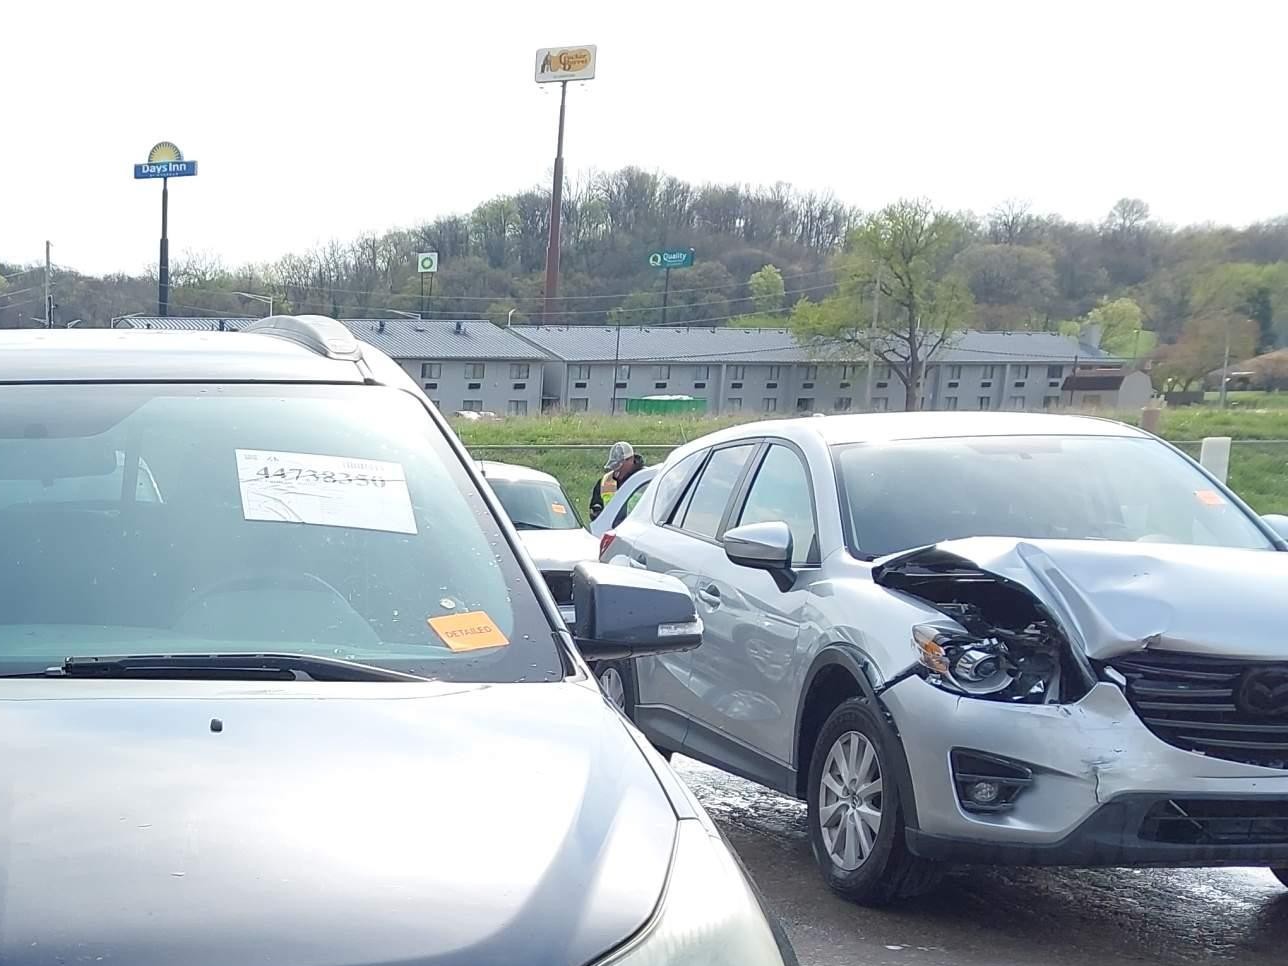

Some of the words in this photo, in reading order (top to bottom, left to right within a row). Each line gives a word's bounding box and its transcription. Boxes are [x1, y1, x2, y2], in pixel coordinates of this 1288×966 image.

[141, 164, 168, 174] Days
[169, 162, 187, 172] Inn
[663, 252, 687, 262] Quality
[256, 466, 387, 489] 44738350
[445, 625, 493, 639] DETAILED
